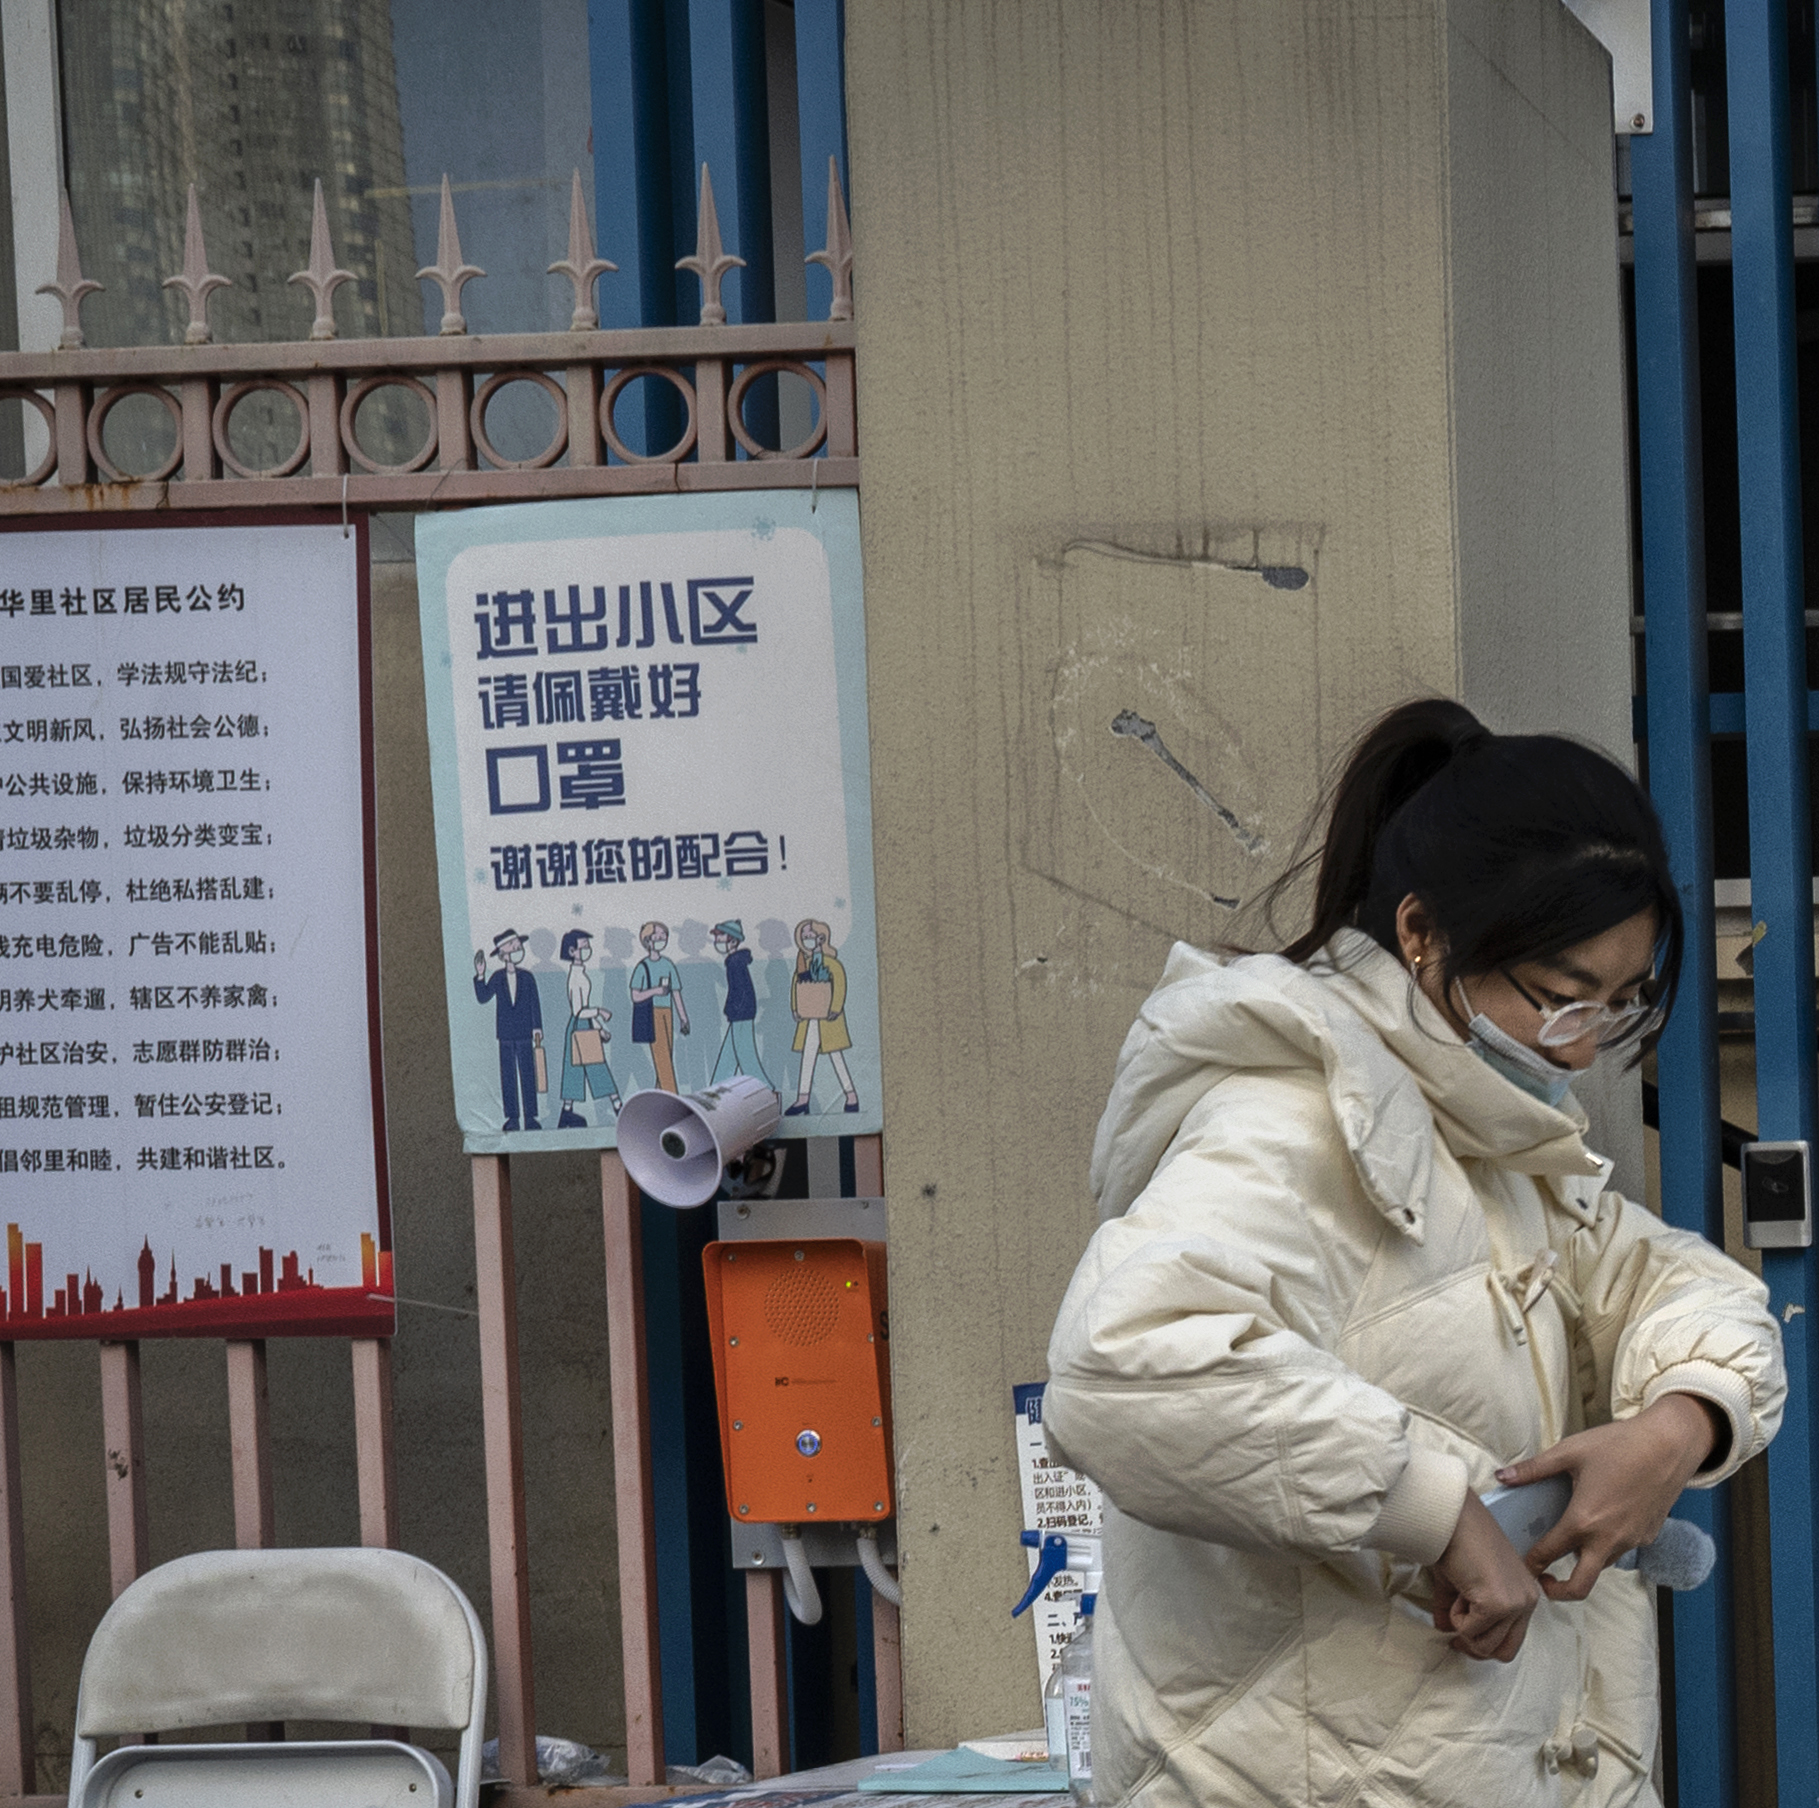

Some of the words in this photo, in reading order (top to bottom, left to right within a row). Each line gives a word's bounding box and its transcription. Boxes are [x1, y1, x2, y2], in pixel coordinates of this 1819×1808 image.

[474, 575, 759, 661] 进出小区
[476, 662, 702, 731] 请佩戴好
[0, 713, 270, 744] 文明新风，弘扬社会公德；
[0, 768, 272, 798] 公共设施，保持环境卫生；
[485, 738, 626, 816] 口罩
[0, 821, 274, 852] 垃圾杂物，垃圾分类变宝；
[489, 829, 789, 892] 谢谢您的配合！
